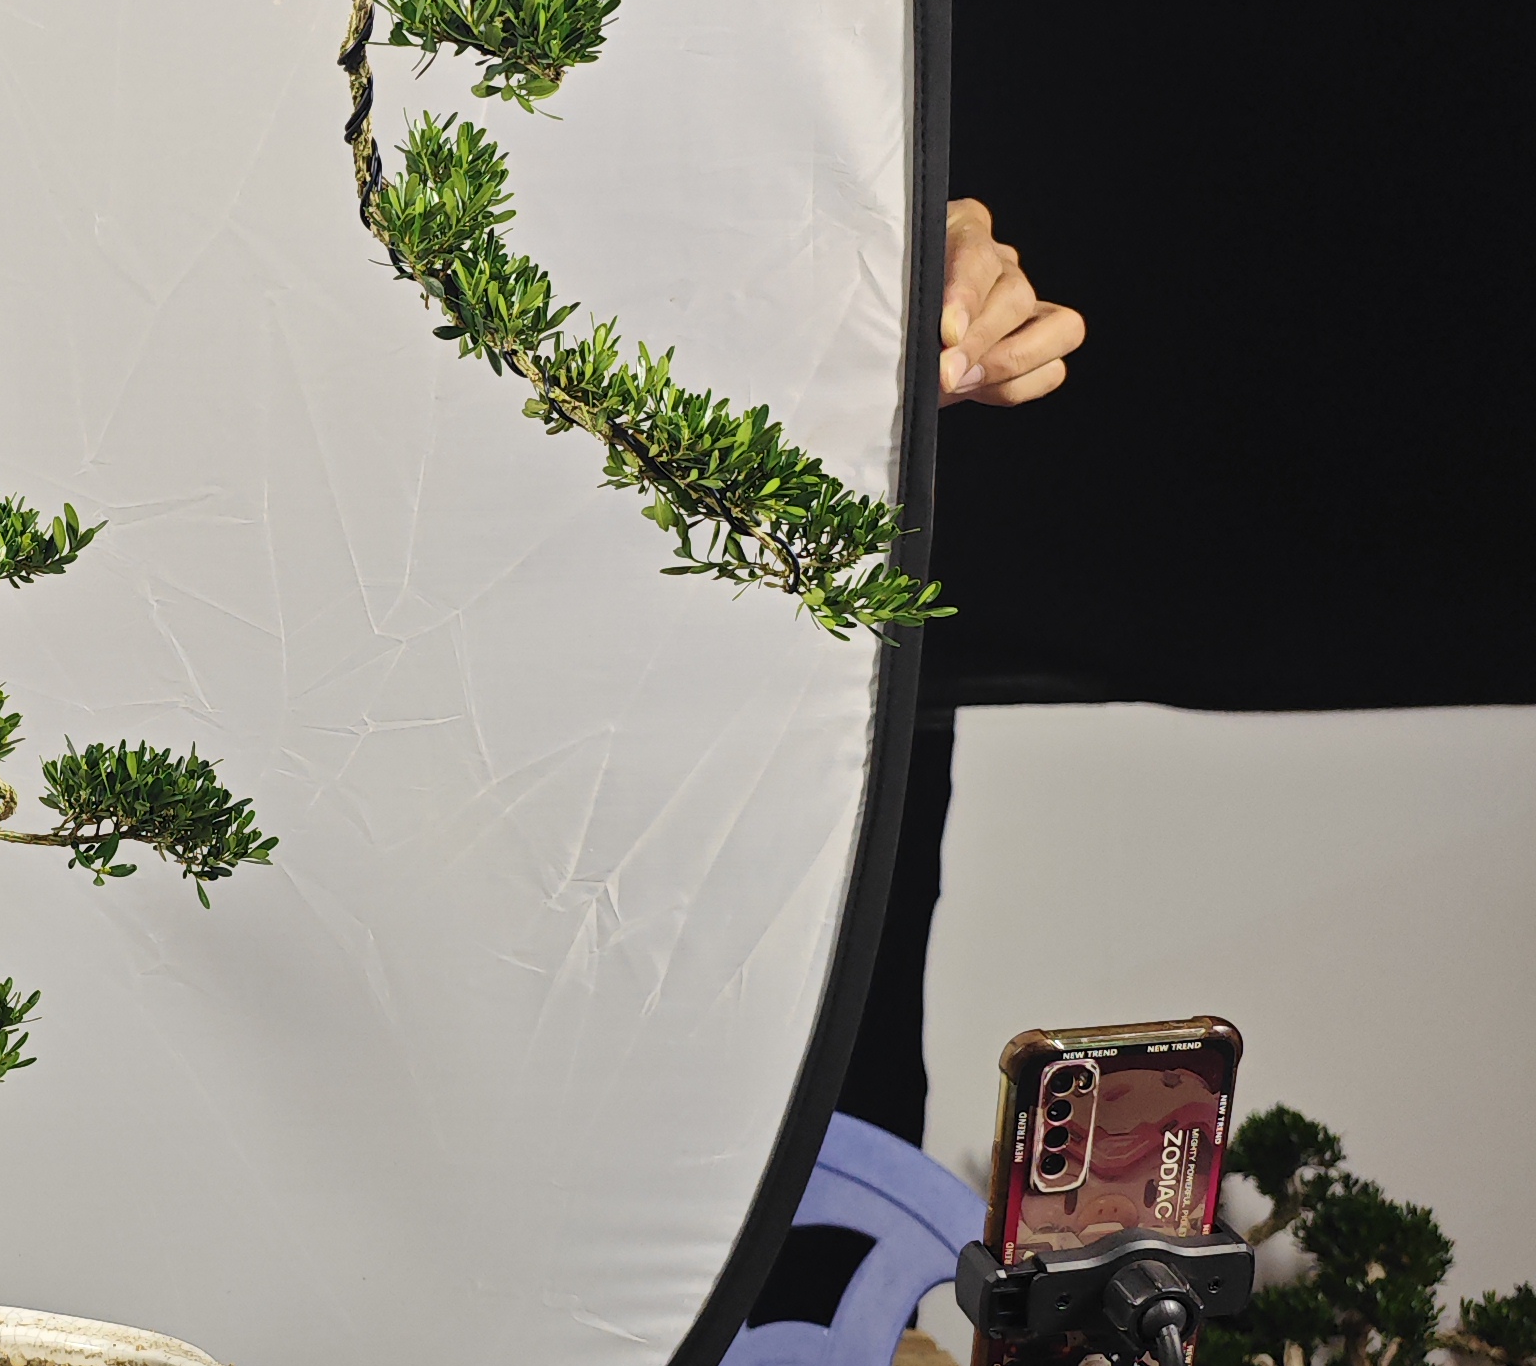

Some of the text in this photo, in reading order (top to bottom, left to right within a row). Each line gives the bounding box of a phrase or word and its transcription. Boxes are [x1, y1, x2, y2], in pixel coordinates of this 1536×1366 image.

[1062, 1048, 1118, 1060] NEW TREND
[1147, 1041, 1202, 1053] NEW TREND
[1014, 1111, 1028, 1163] NEW TREND
[1214, 1094, 1228, 1145] NEW TREND
[1189, 1128, 1200, 1162] MIGHTY
[1154, 1129, 1184, 1219] ZODIAC
[1182, 1163, 1196, 1208] POWERFUL
